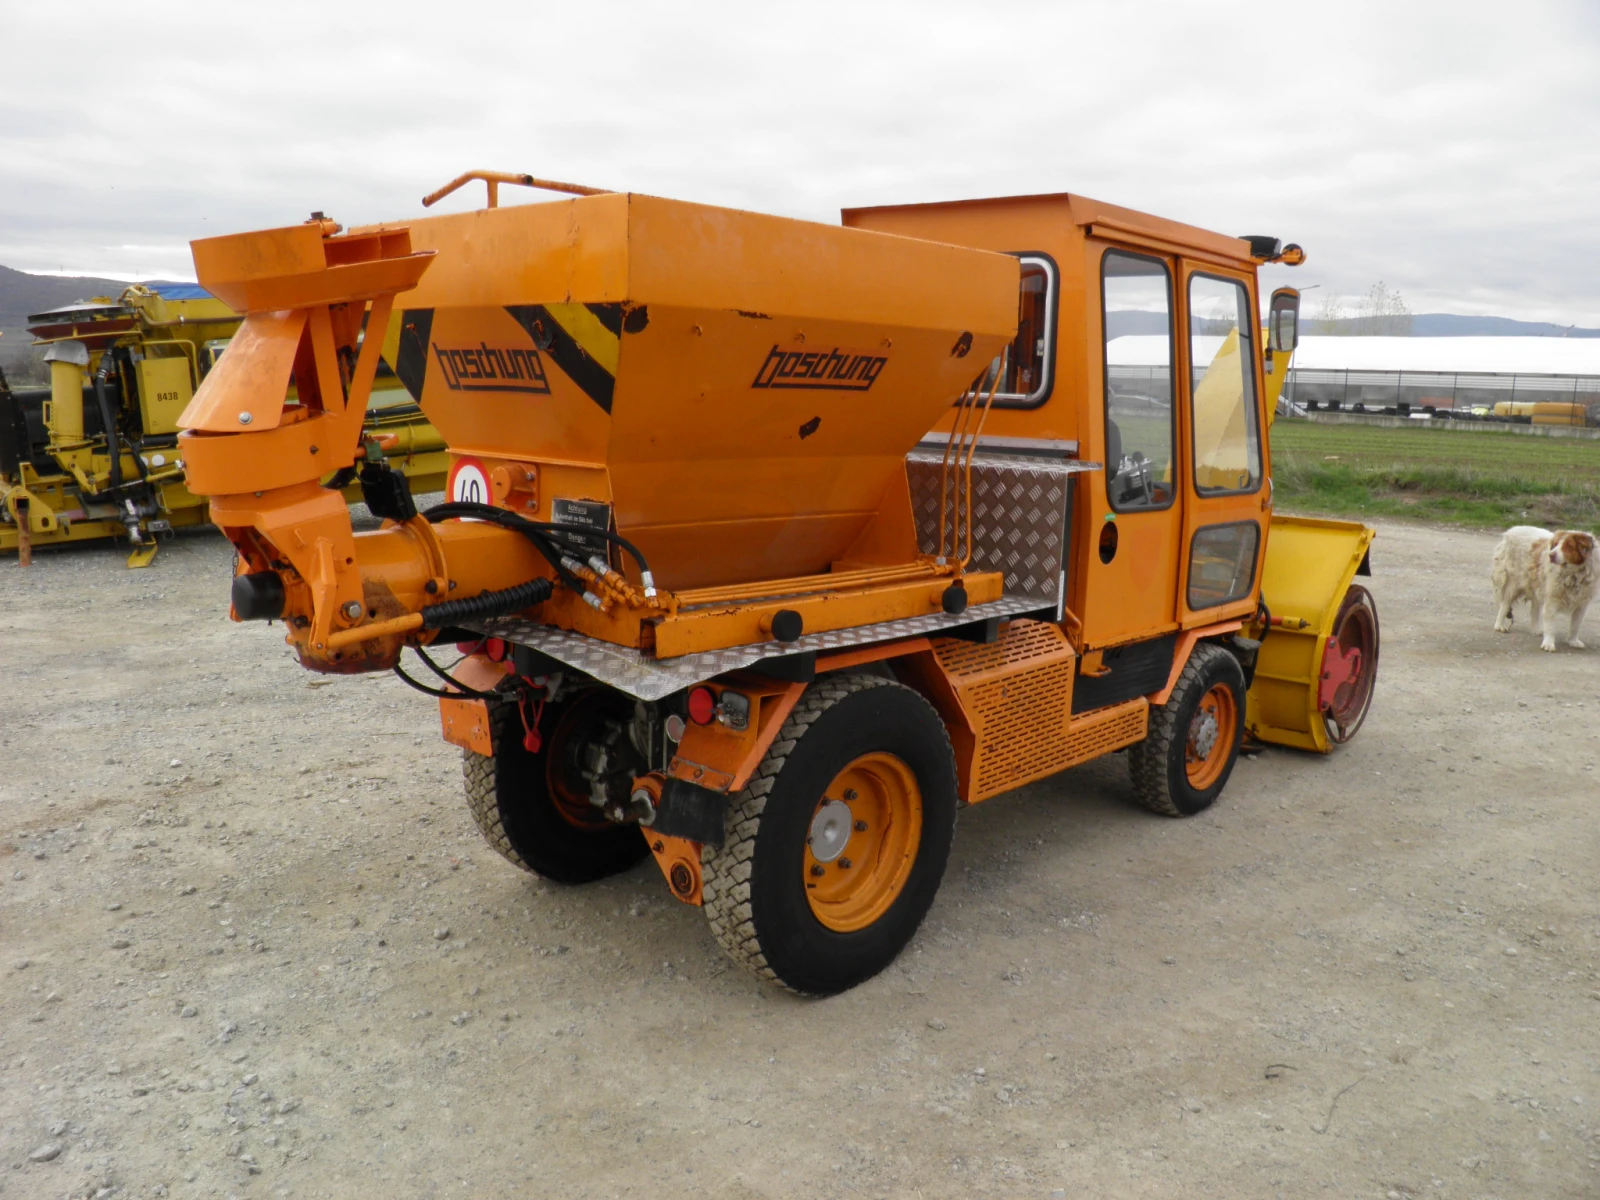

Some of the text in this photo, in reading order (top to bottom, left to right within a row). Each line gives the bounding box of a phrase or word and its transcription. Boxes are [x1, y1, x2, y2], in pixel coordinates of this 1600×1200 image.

[157, 392, 178, 401] 8438
[460, 479, 480, 503] 40
[567, 504, 587, 514] Achtung
